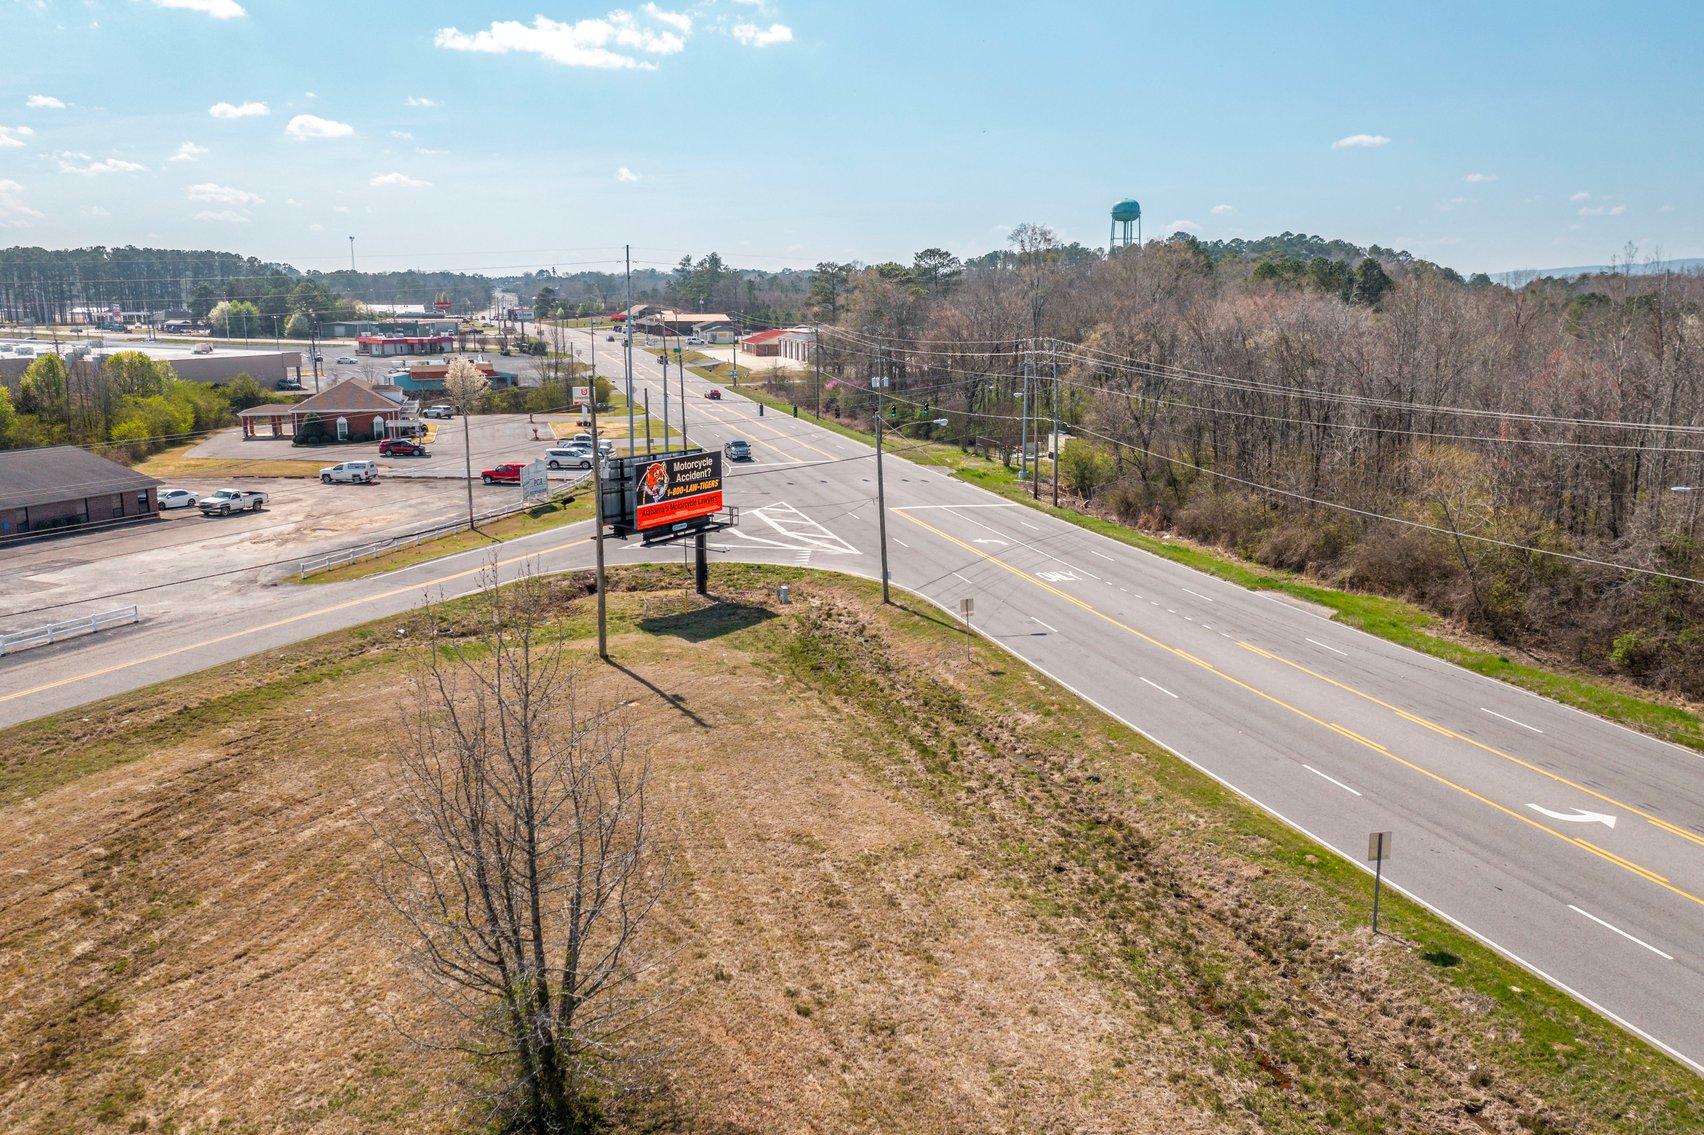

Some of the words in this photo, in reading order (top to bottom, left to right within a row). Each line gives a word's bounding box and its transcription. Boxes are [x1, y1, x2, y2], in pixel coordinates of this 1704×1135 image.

[673, 457, 713, 472] Motorcycle
[675, 467, 712, 482] Accident?
[667, 479, 720, 497] 1-800-LAW-TIGERS
[670, 499, 697, 511] Motorcycle
[697, 495, 718, 505] Lawyers
[1035, 570, 1082, 582] ONLY
